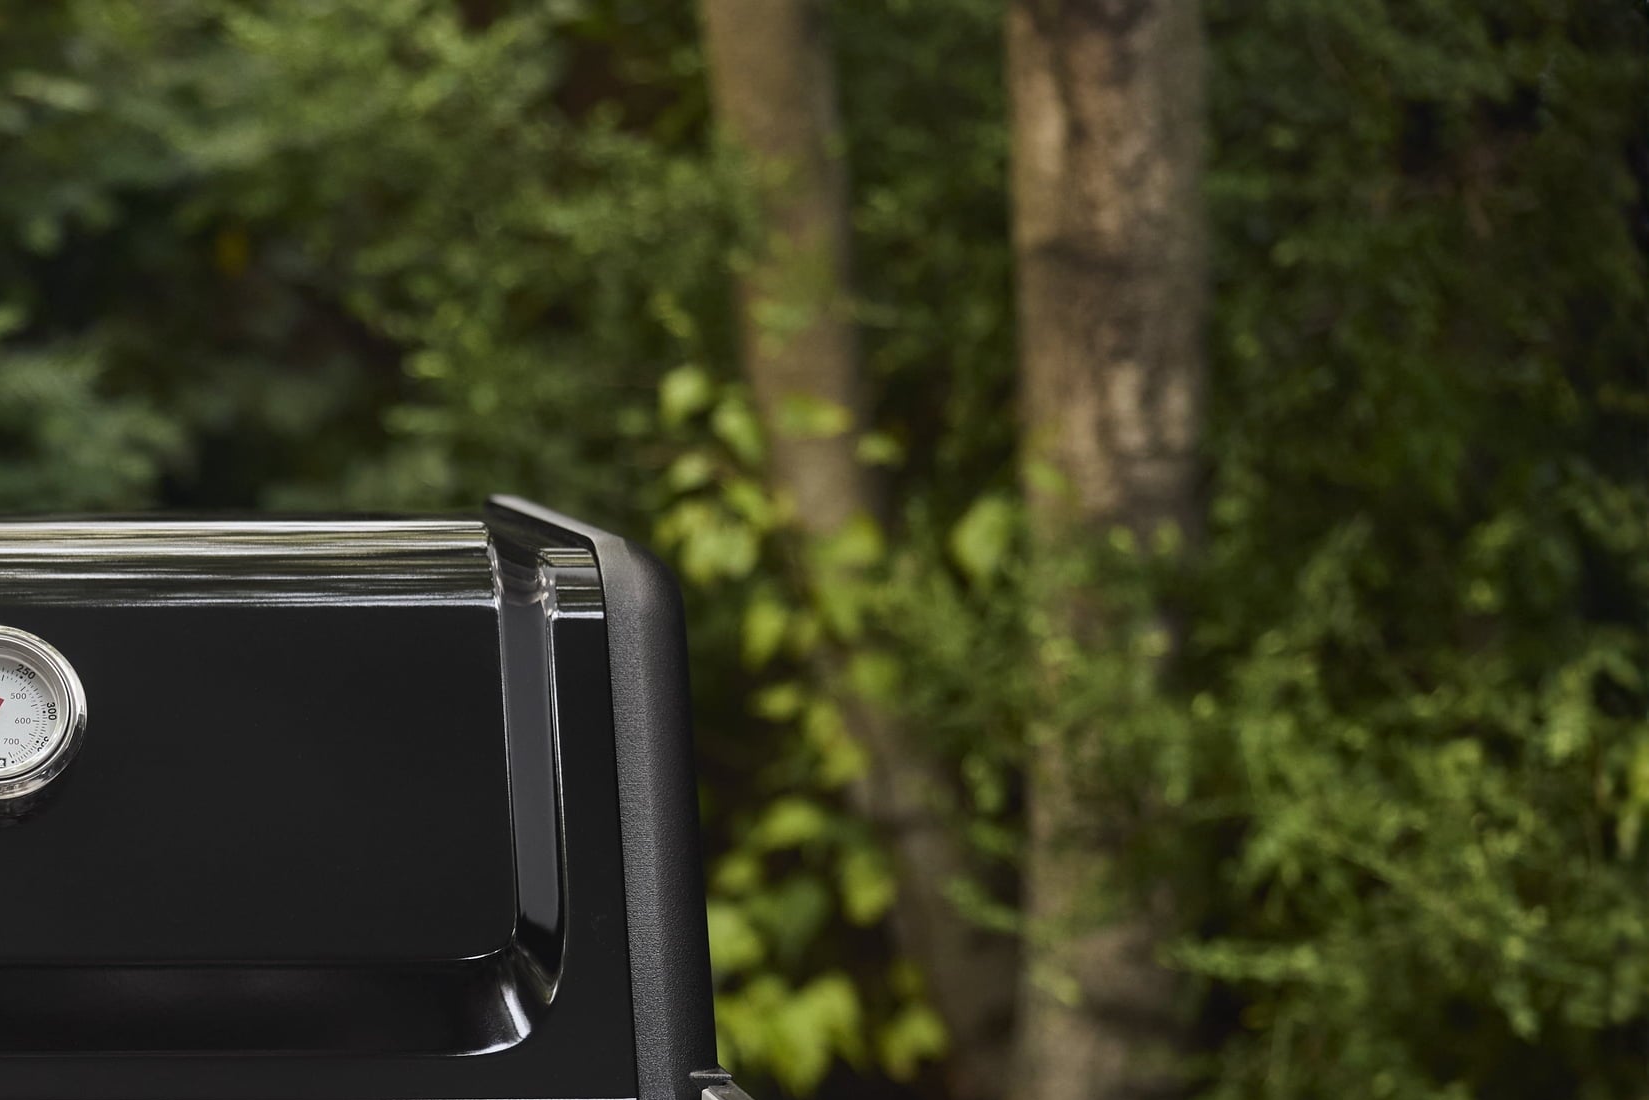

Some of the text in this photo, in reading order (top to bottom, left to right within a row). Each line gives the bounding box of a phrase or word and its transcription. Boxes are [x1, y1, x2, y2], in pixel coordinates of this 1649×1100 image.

[16, 664, 36, 679] 250
[46, 702, 57, 720] 300
[14, 717, 31, 725] 600
[3, 737, 20, 745] 700
